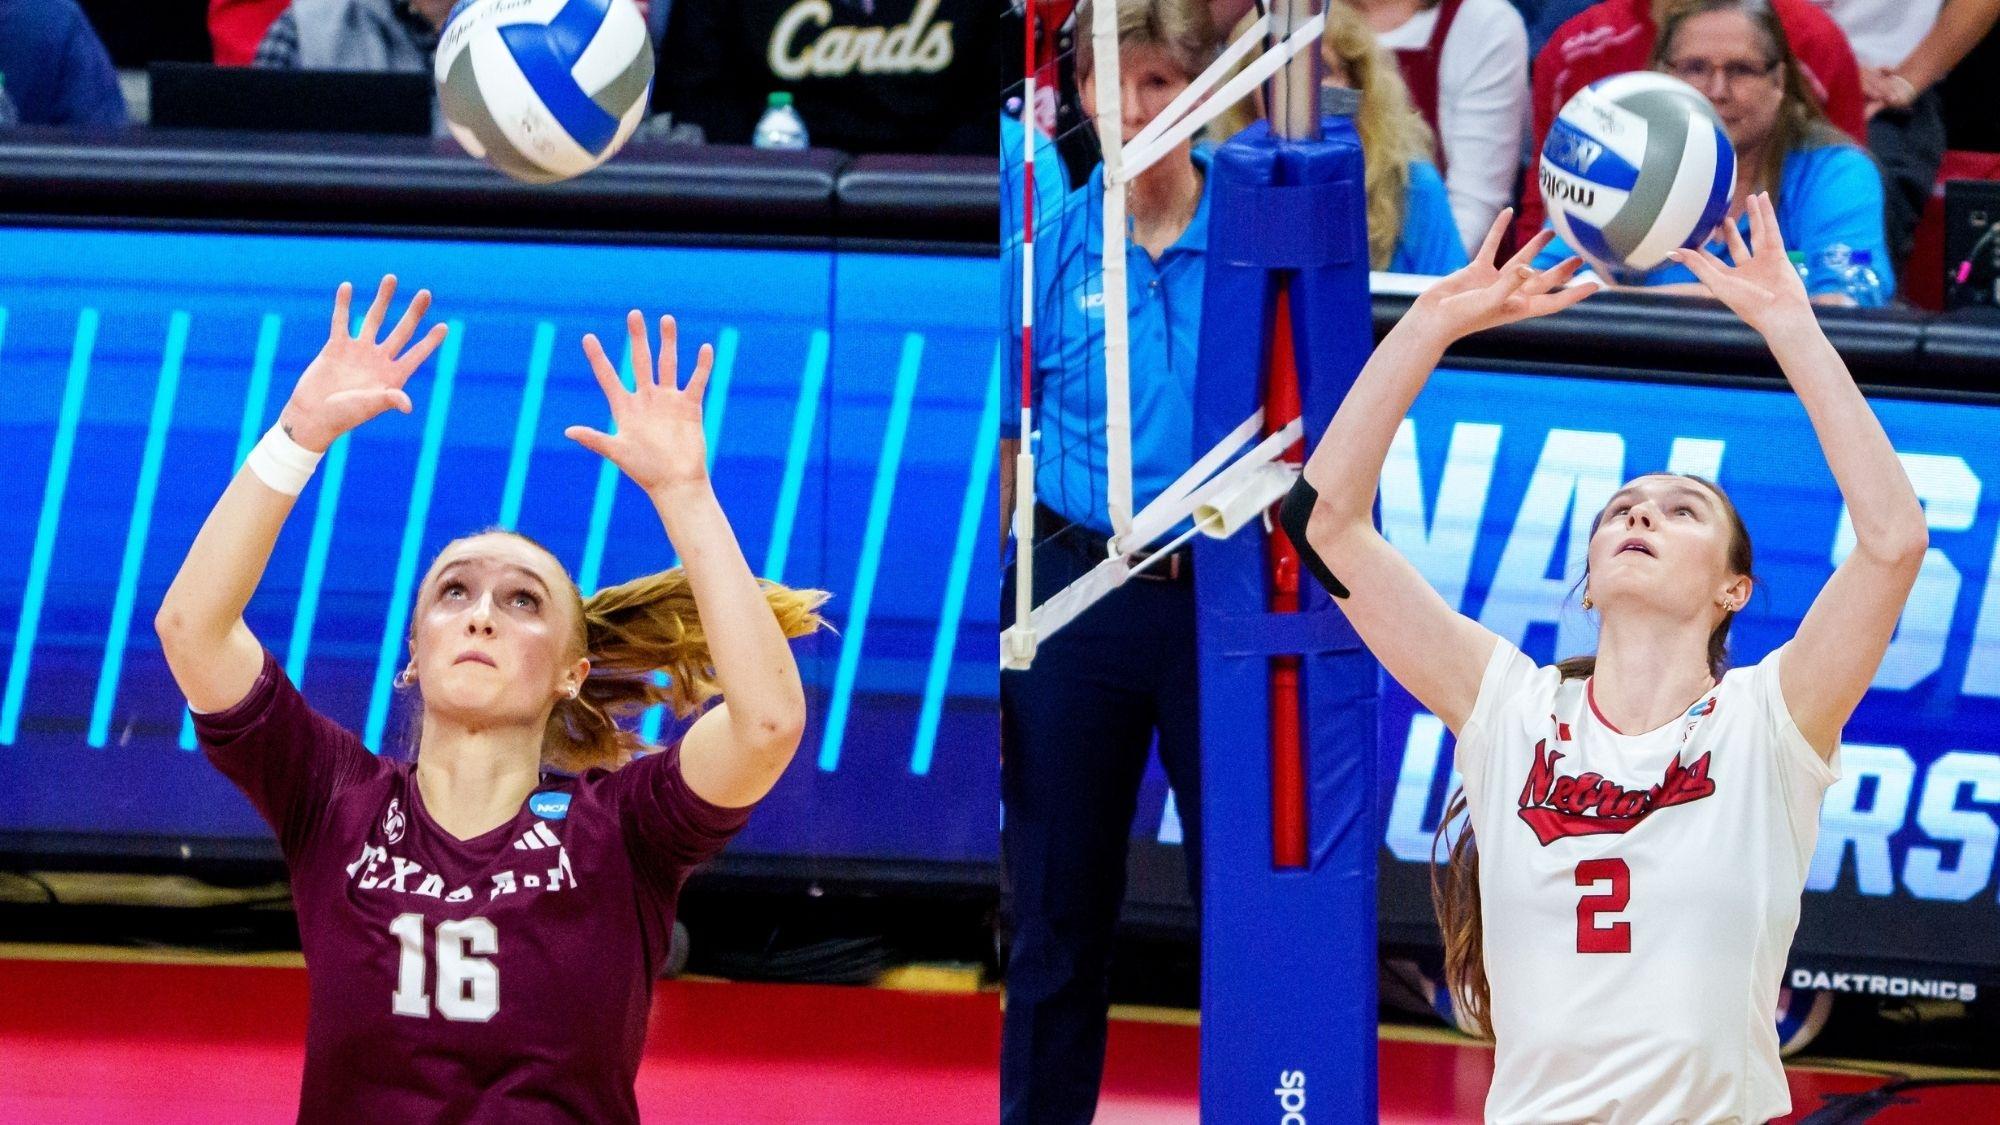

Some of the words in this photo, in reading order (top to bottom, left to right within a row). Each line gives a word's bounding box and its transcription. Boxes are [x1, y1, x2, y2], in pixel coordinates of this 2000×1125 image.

[767, 0, 954, 79] Cards
[1574, 857, 1631, 953] 2
[389, 912, 500, 1023] 16
[1791, 969, 1977, 1001] DAKTRONICS
